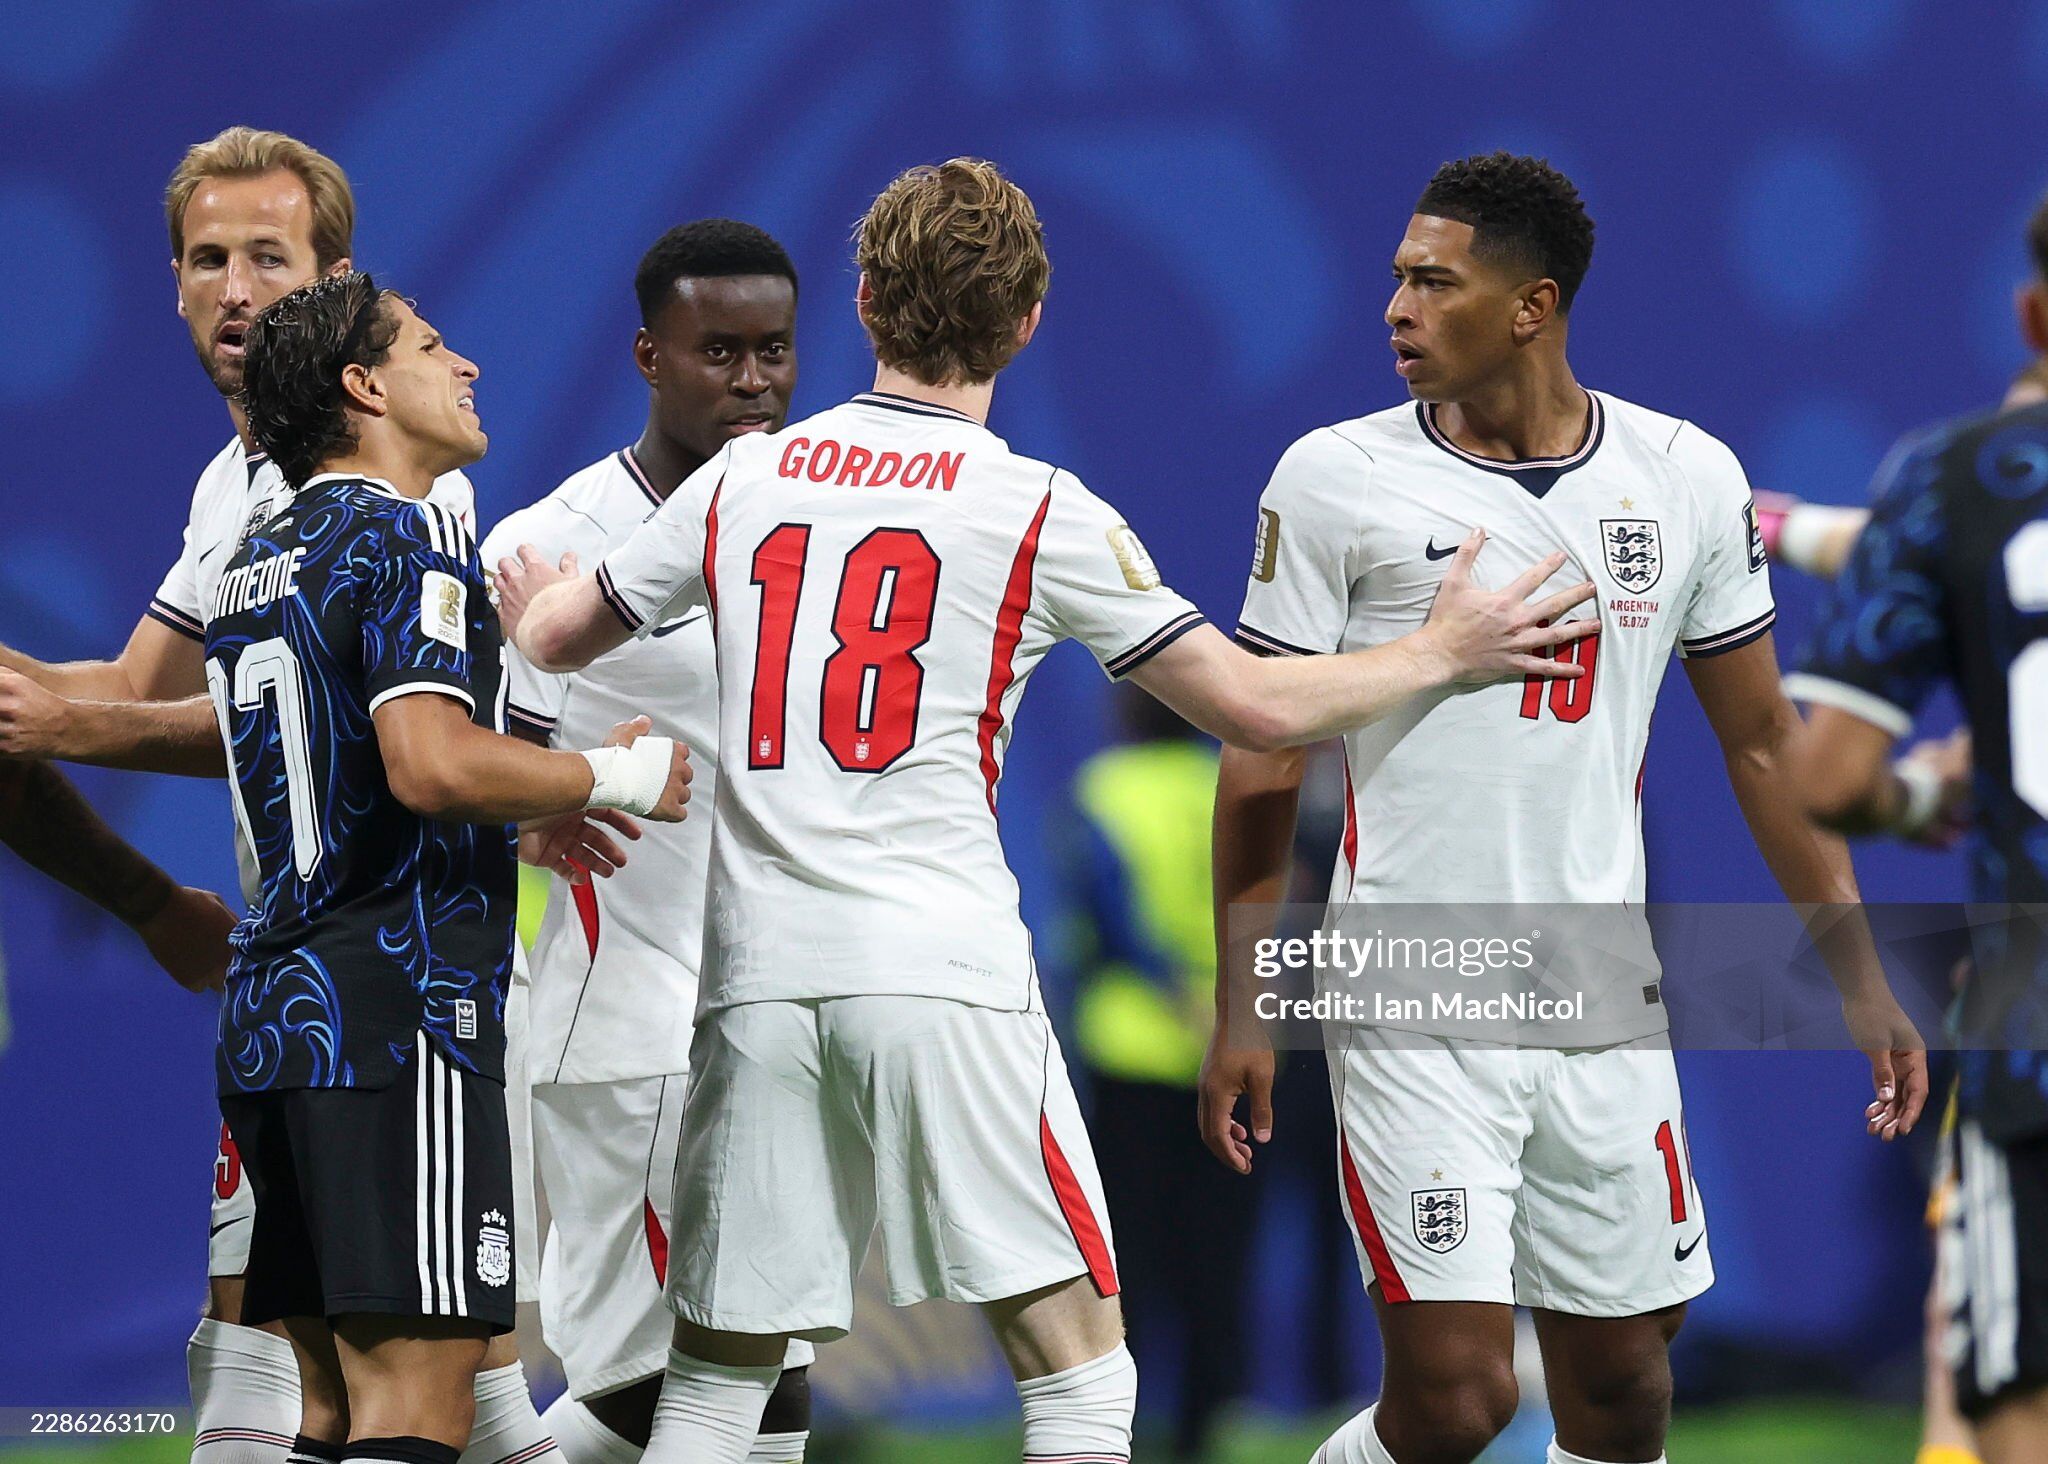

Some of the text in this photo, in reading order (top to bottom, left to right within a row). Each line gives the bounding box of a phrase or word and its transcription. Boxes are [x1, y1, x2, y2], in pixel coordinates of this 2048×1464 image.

[778, 437, 965, 491] GORDON
[748, 522, 941, 773] 18
[1609, 599, 1659, 614] ARGENTINA
[1654, 1108, 1696, 1225] 1
